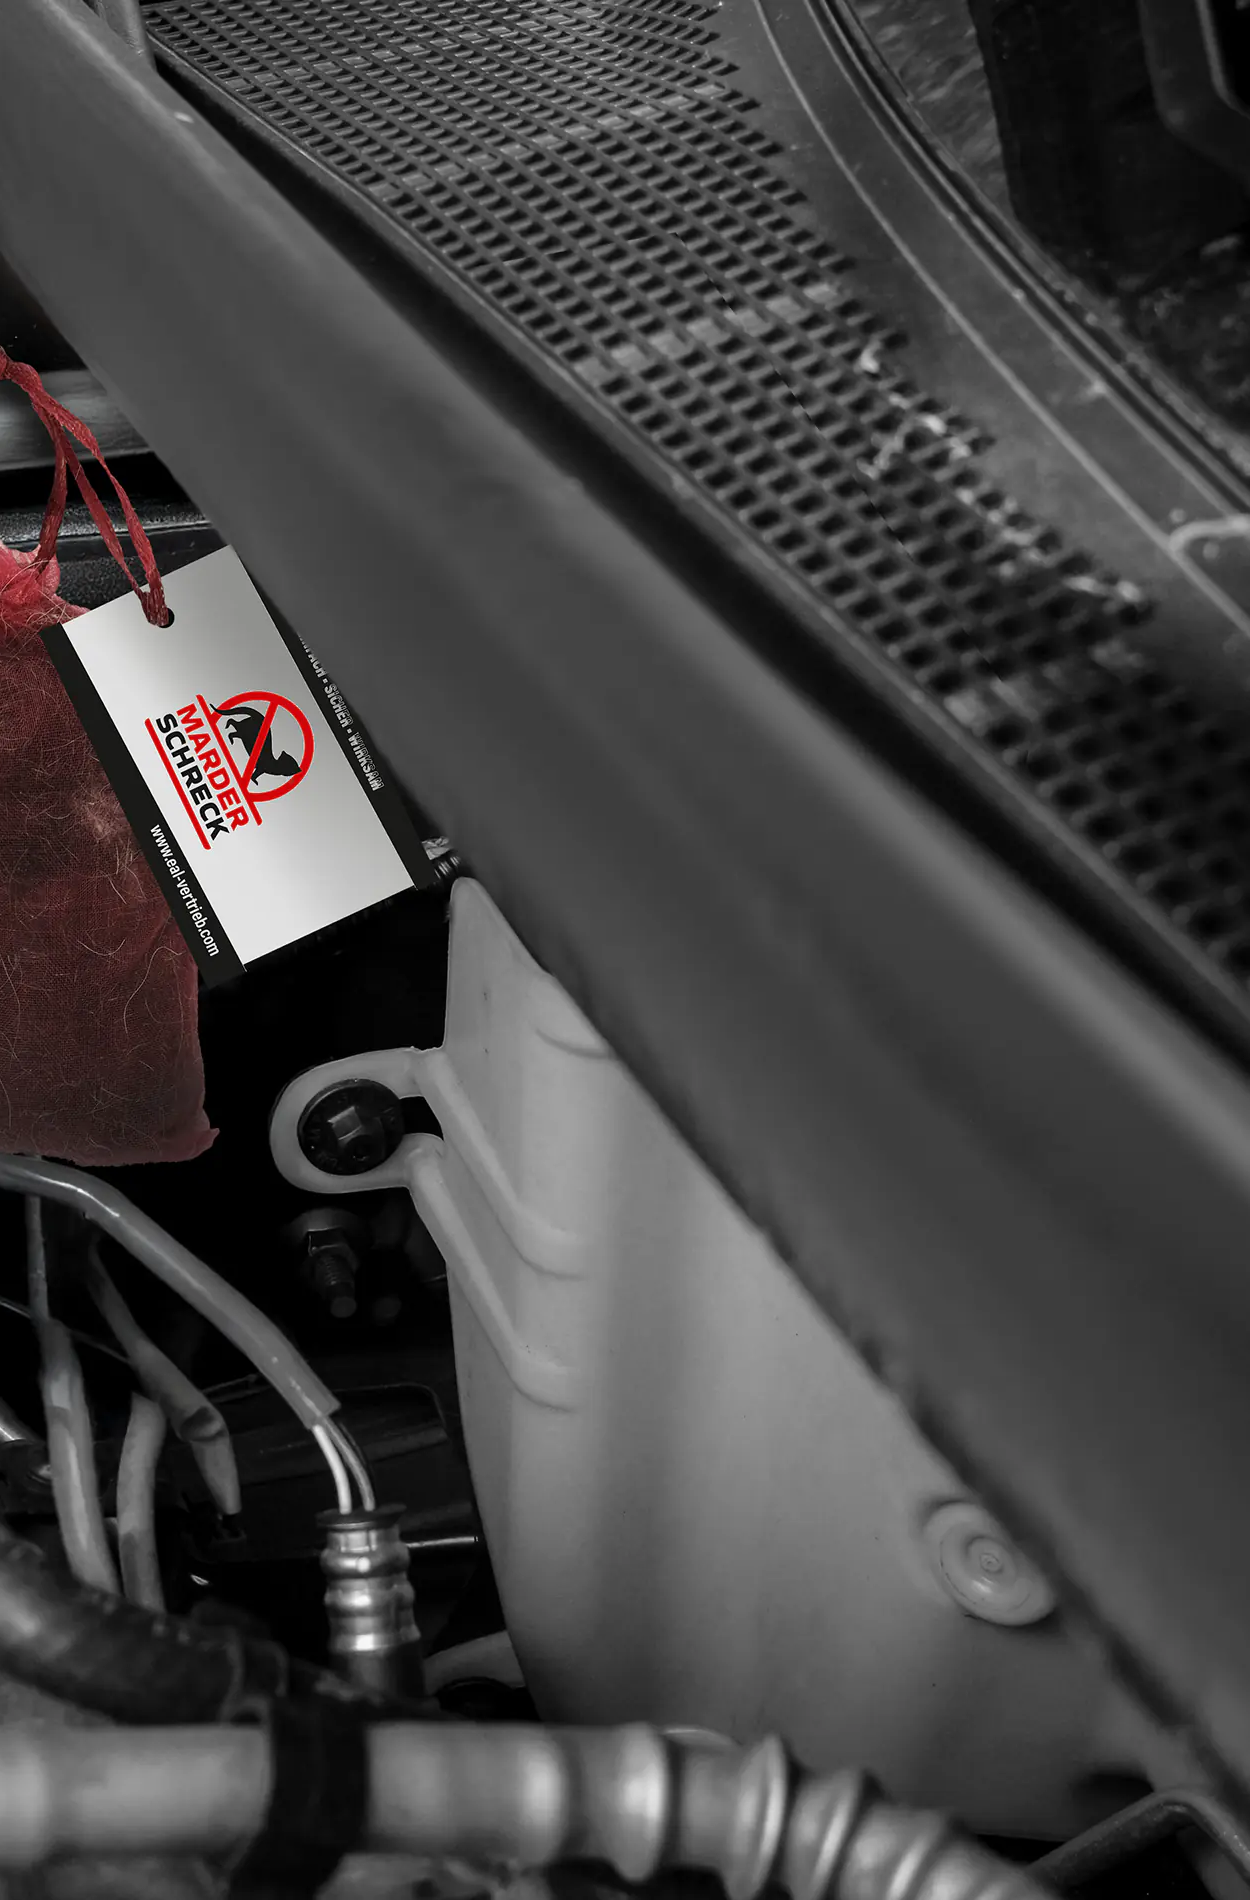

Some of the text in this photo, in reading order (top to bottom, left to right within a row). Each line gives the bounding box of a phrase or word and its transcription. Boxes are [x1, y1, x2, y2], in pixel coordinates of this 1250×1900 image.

[156, 713, 230, 841] SCHRECK
[176, 703, 249, 831] MARDER
[324, 683, 354, 728] SICHER
[348, 731, 384, 792] WIRKSAM
[150, 824, 220, 957] www.eal-vertrieb.com
